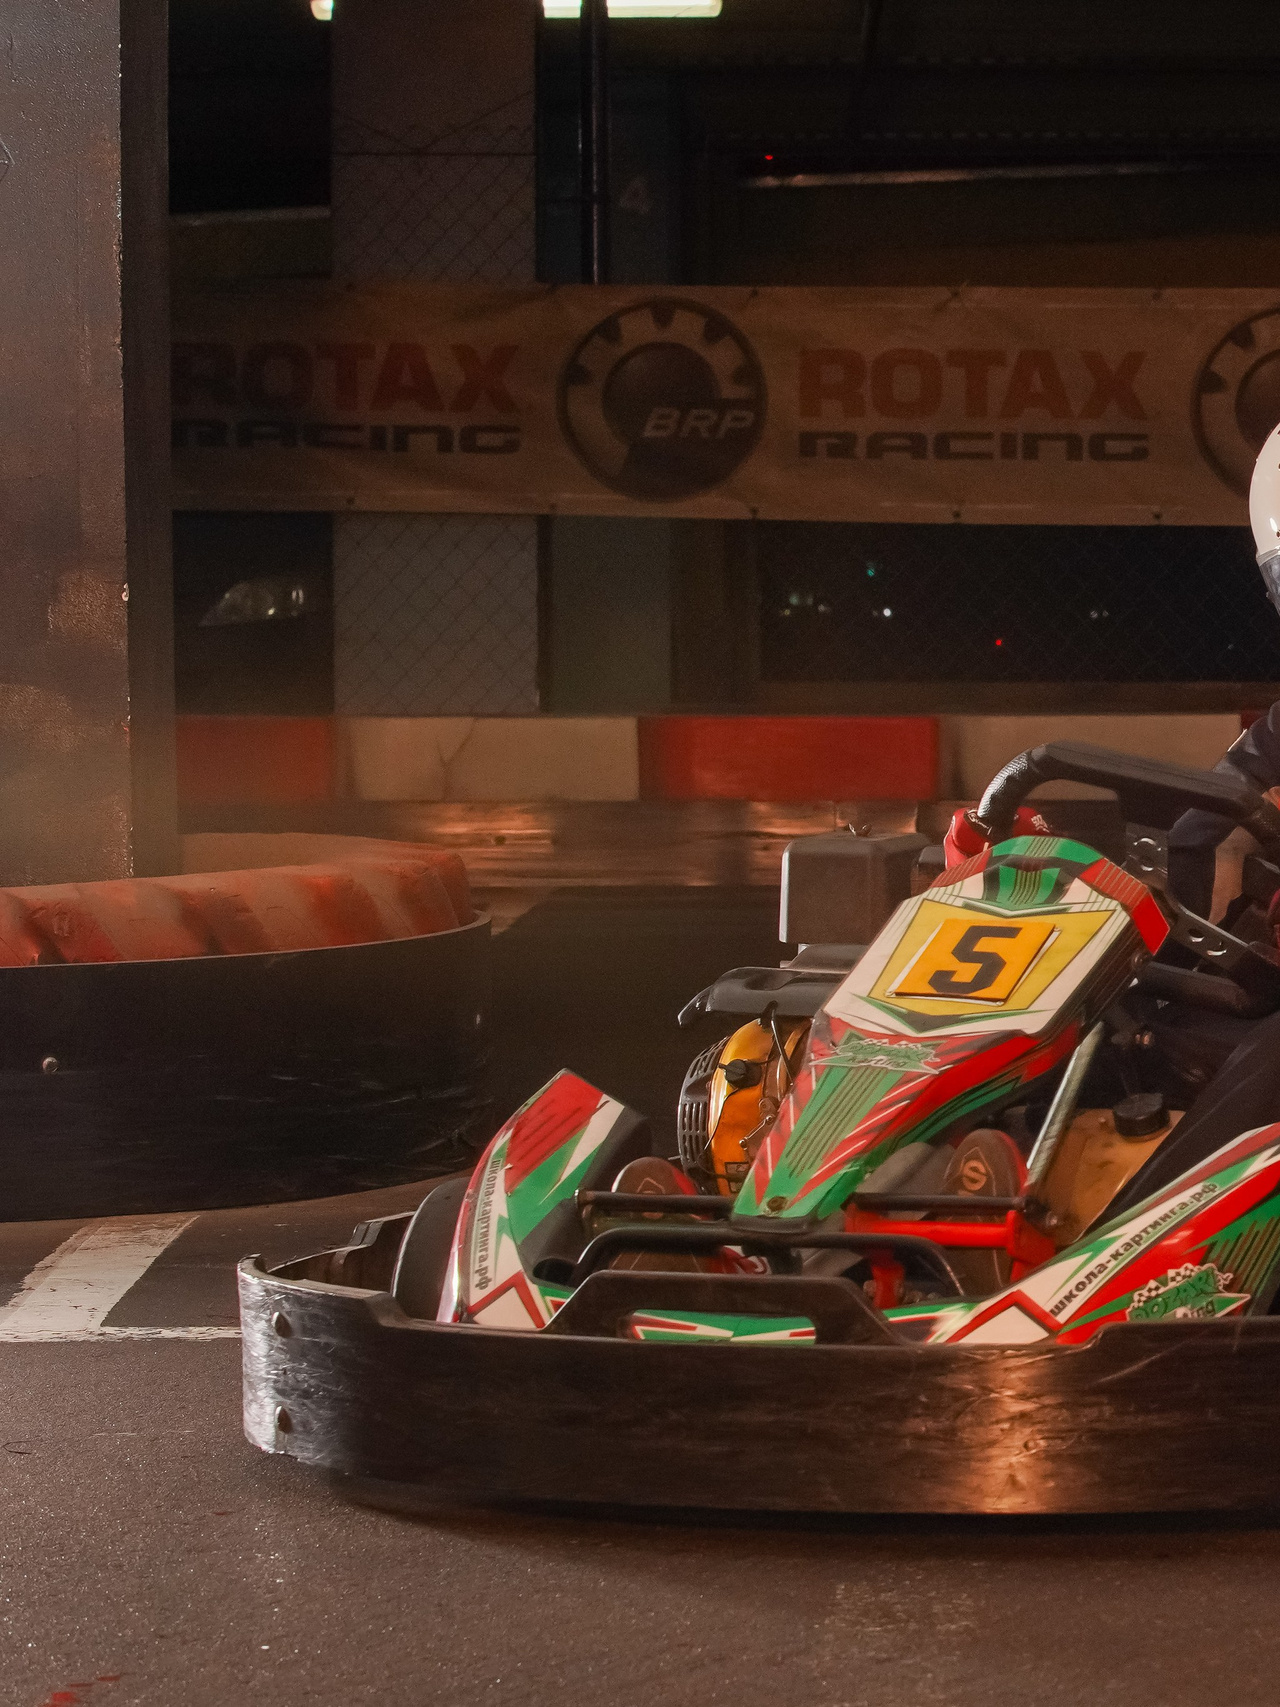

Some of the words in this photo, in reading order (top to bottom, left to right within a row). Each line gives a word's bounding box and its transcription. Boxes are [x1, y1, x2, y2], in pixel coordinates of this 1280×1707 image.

[171, 342, 519, 413] ROTAX
[799, 347, 1148, 420] ROTAX
[171, 419, 521, 453] RACING
[643, 405, 755, 439] BRP
[799, 431, 1149, 462] RACING
[928, 925, 1024, 995] 5
[1049, 1182, 1219, 1317] школа-картинга.рф
